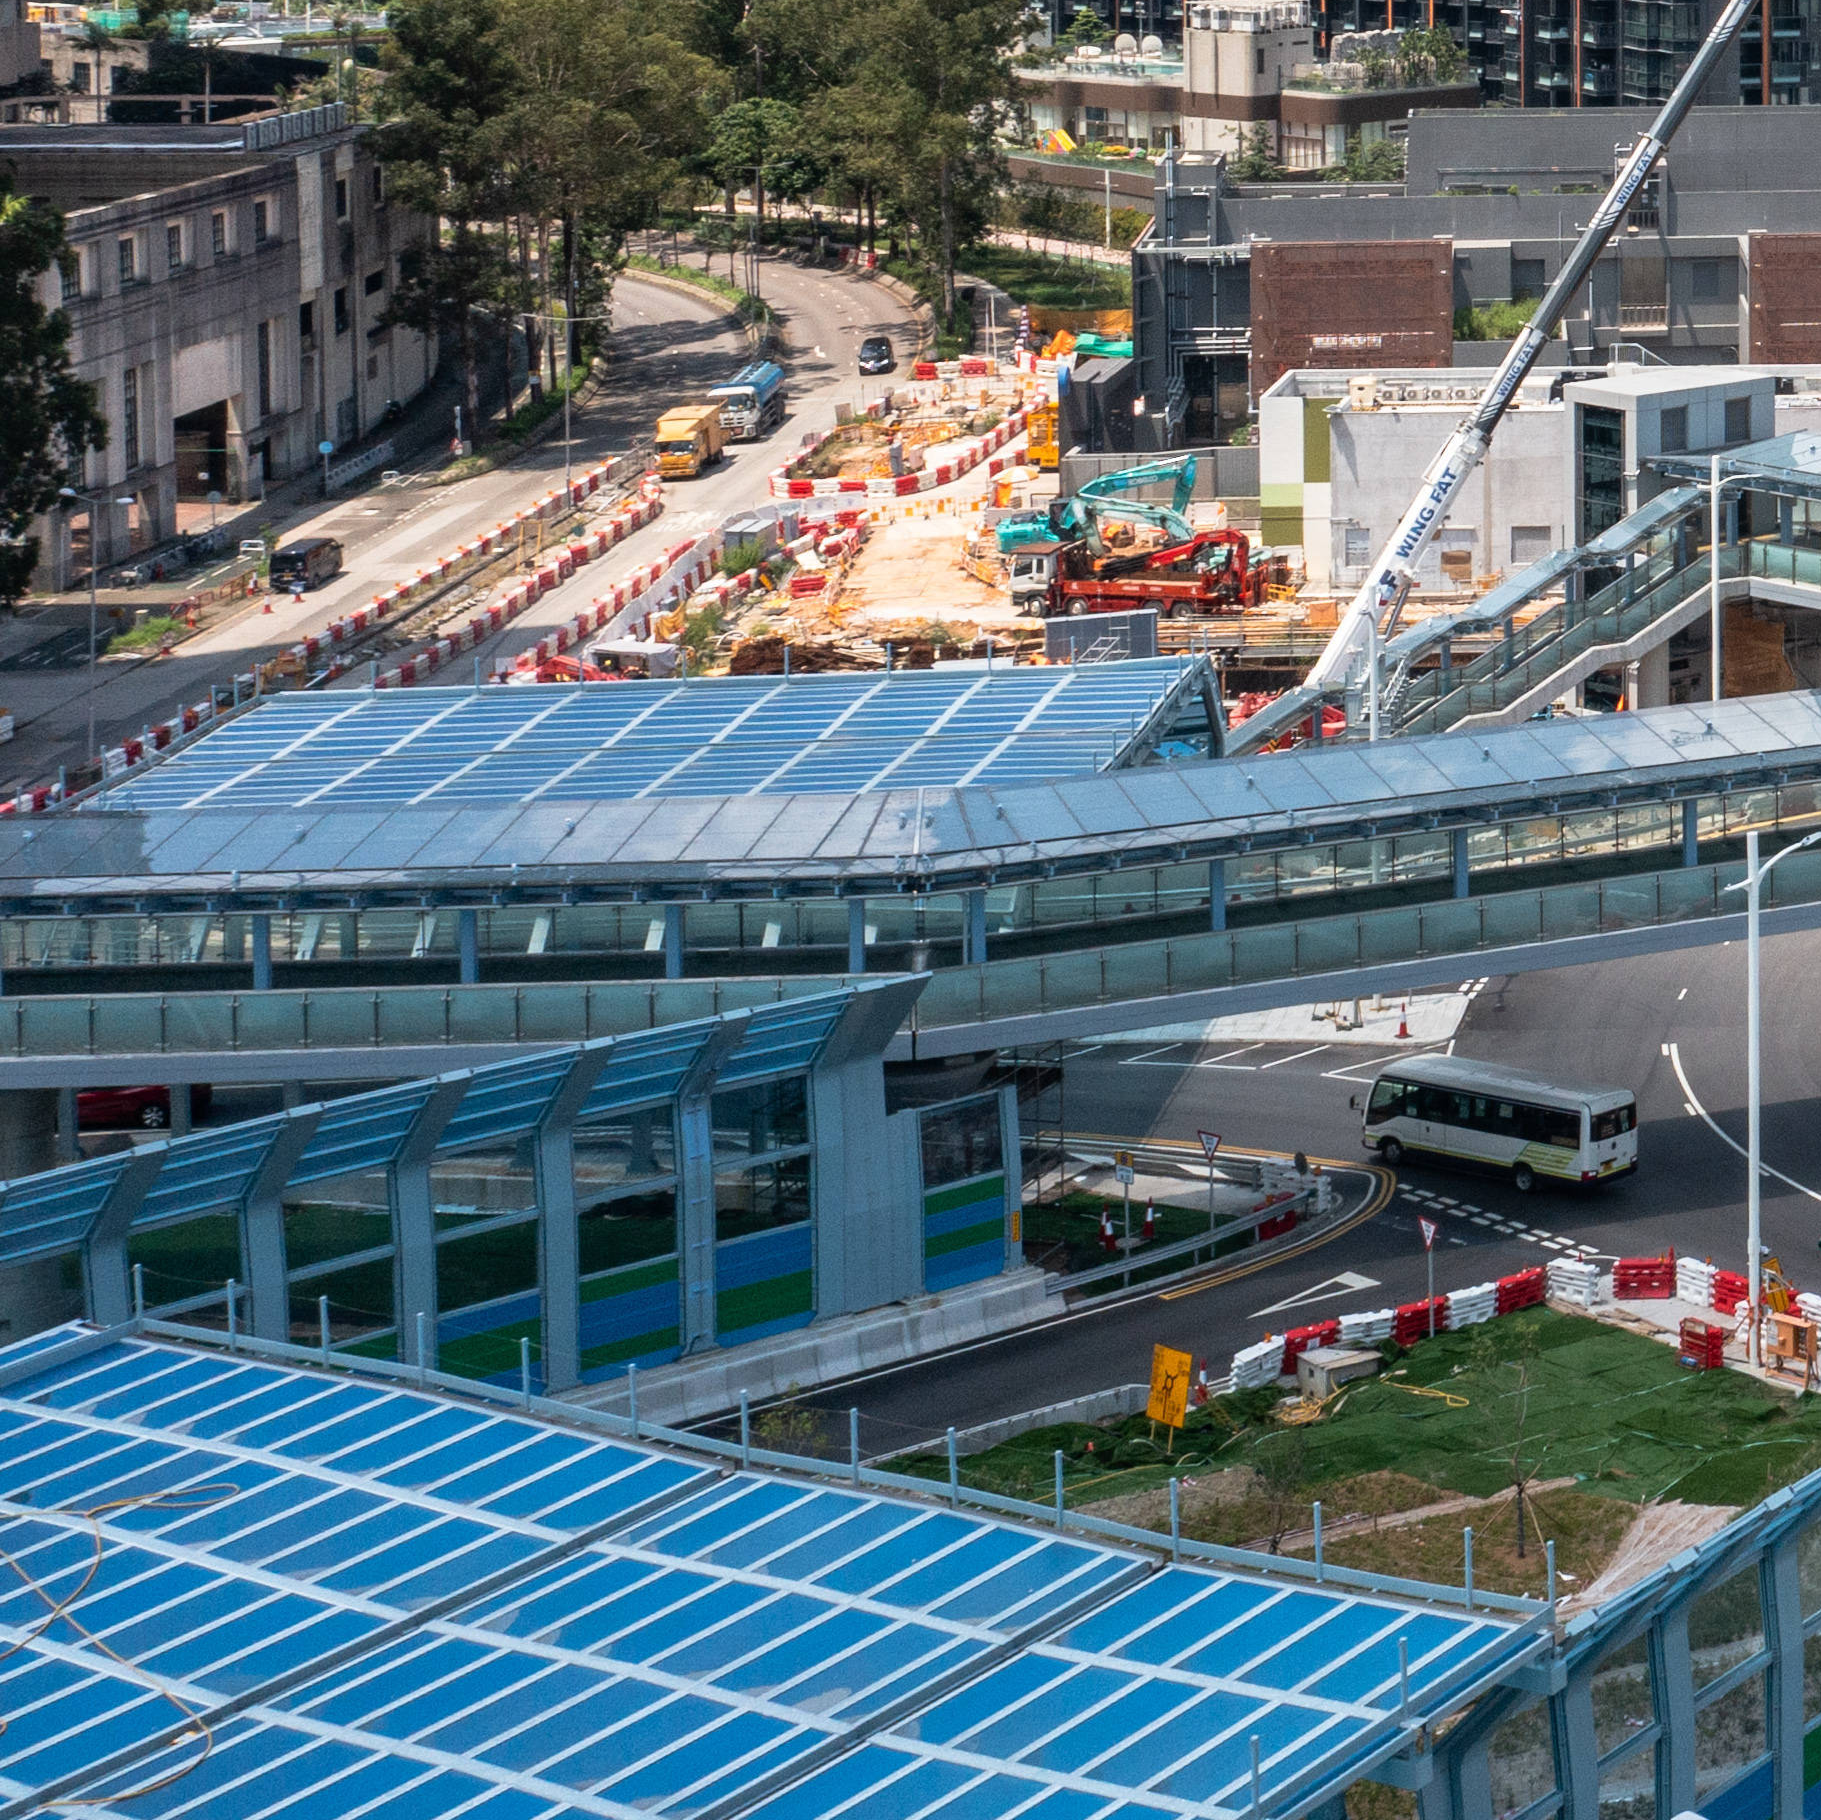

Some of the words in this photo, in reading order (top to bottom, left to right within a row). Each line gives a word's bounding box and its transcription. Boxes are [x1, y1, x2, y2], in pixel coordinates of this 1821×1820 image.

[1615, 175, 1640, 205] WING
[1636, 151, 1653, 173] FAT
[1497, 365, 1521, 397] WING
[1518, 342, 1535, 364] FAT
[1396, 506, 1435, 559] WING
[1430, 467, 1457, 504] FAT
